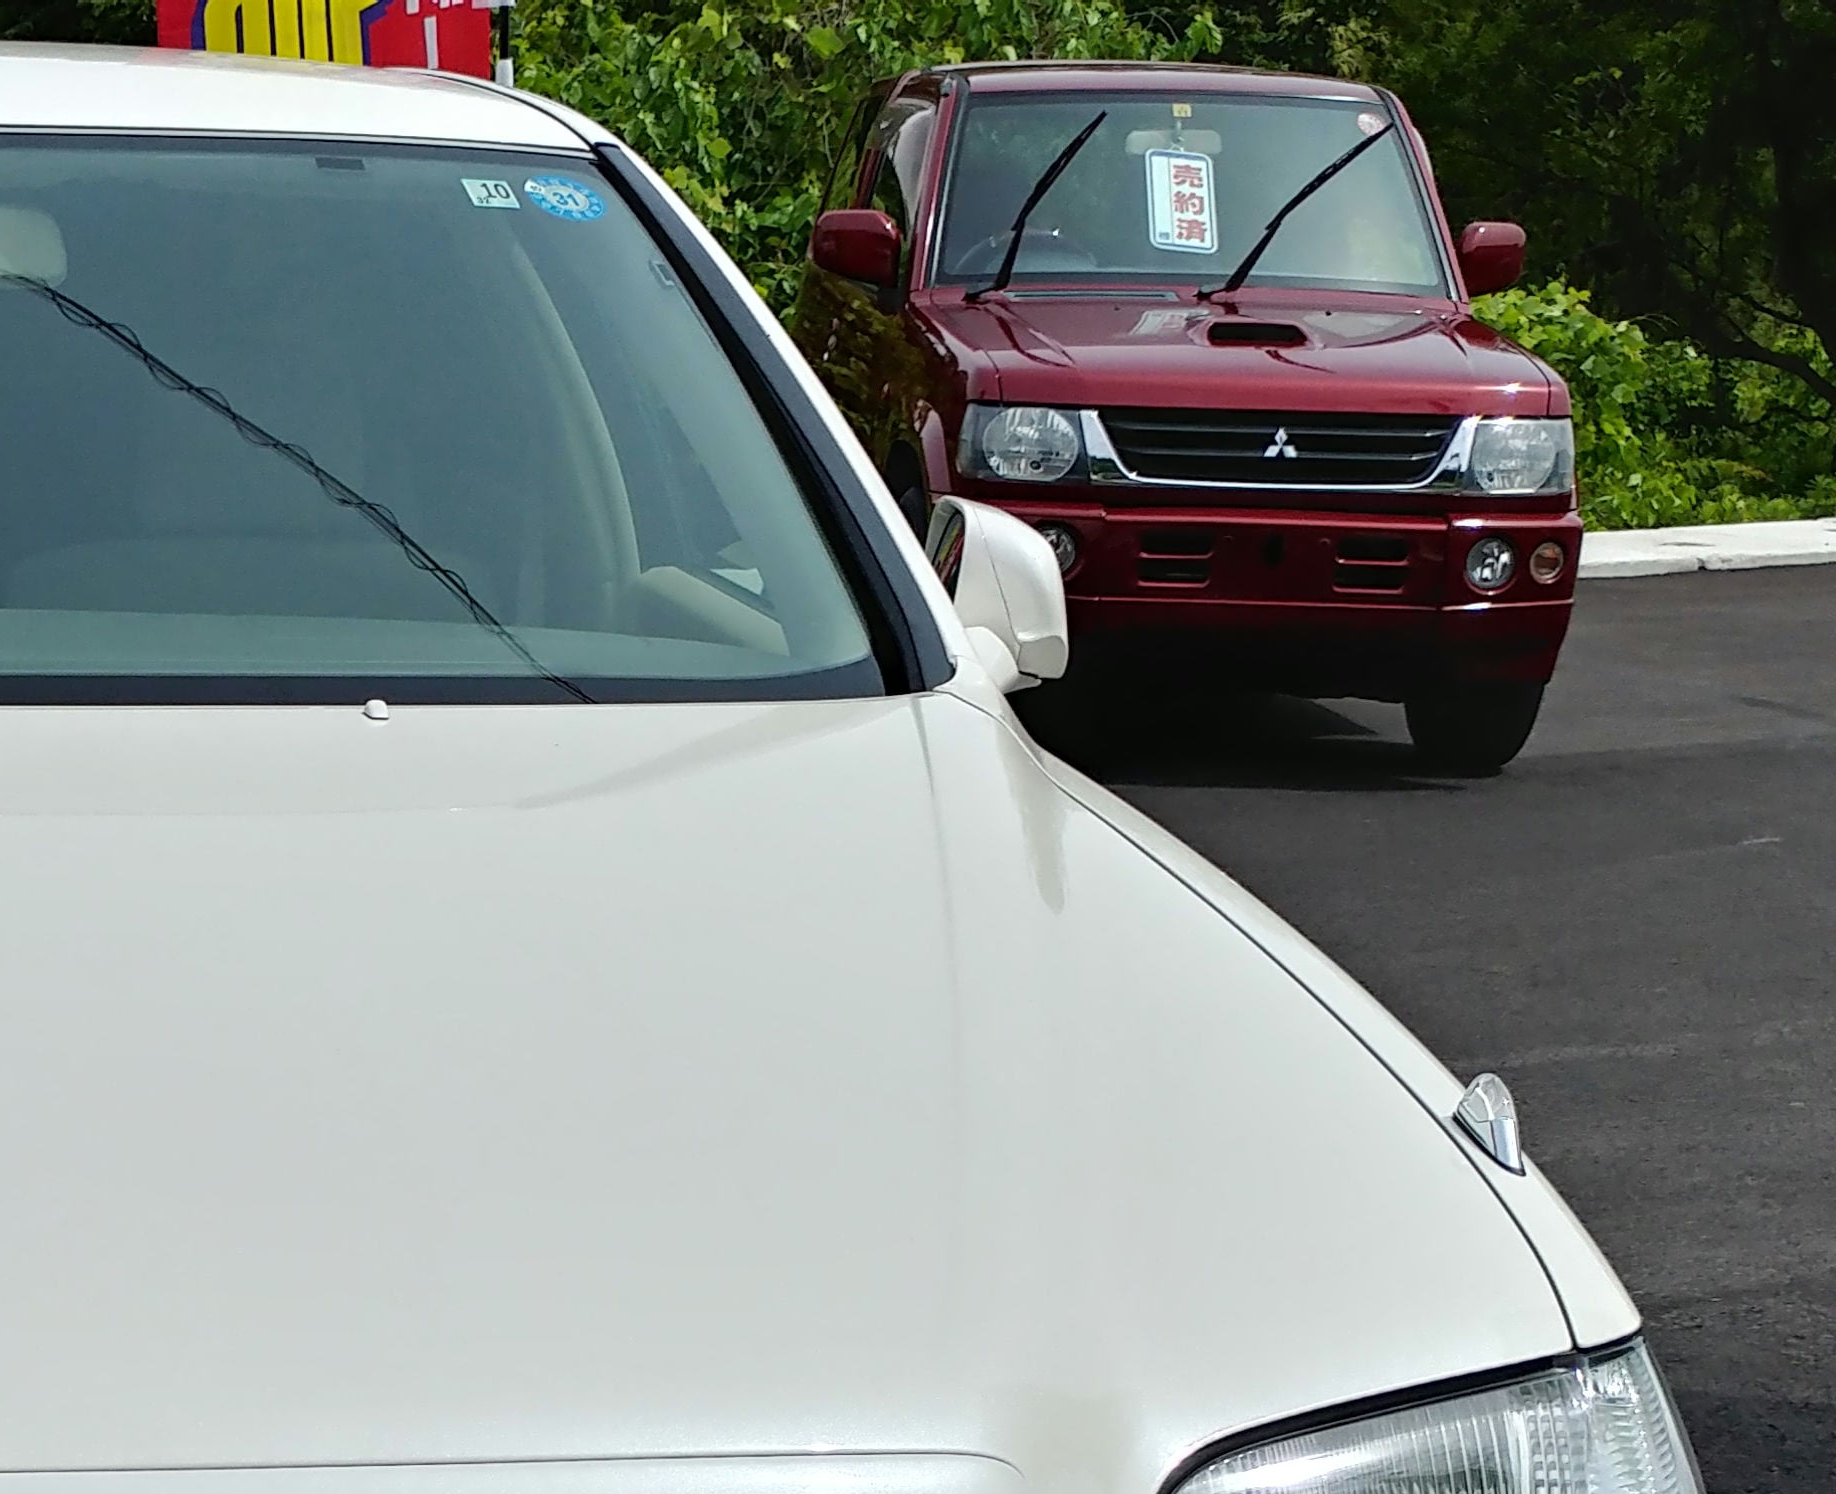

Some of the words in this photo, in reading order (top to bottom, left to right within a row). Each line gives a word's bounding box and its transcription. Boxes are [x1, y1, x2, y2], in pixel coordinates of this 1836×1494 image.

[480, 183, 510, 200] 10
[552, 192, 580, 207] 31
[1173, 164, 1207, 243] 売約済
